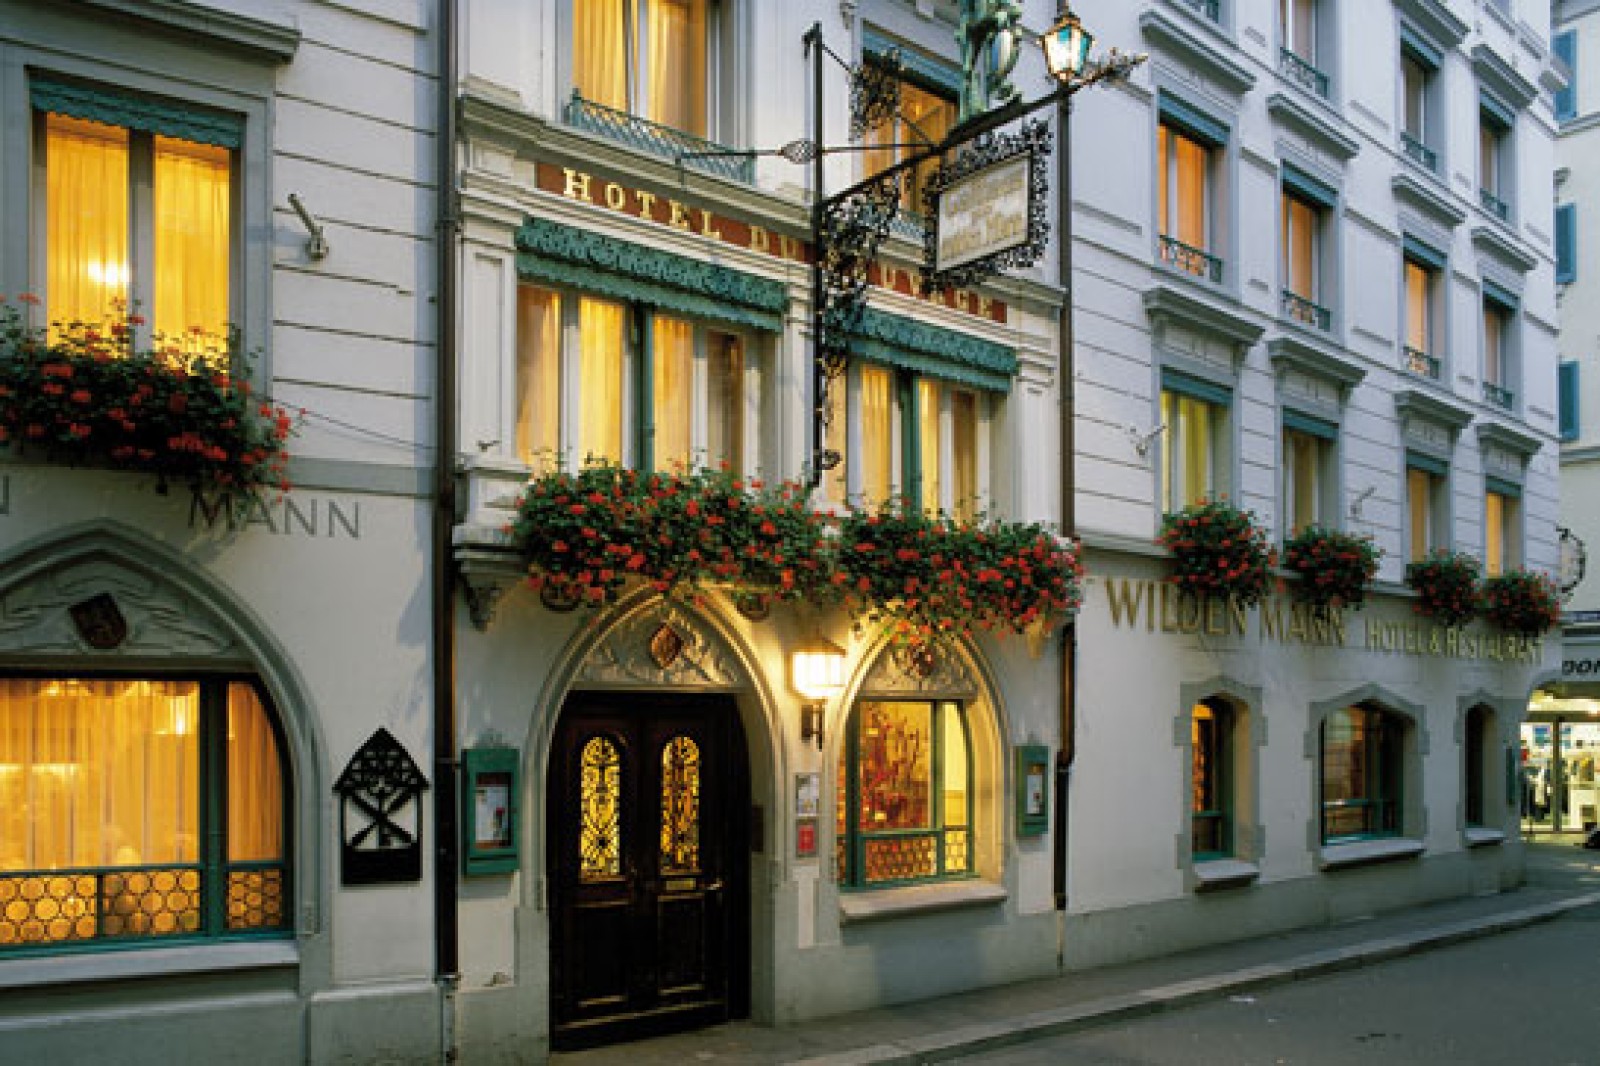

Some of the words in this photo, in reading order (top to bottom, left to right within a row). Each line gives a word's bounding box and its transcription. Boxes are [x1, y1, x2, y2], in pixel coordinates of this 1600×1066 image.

[563, 167, 722, 240] HOTEL
[188, 490, 360, 539] MANN
[1105, 575, 1247, 641] WILDEN
[1365, 616, 1425, 656] HOTEL
